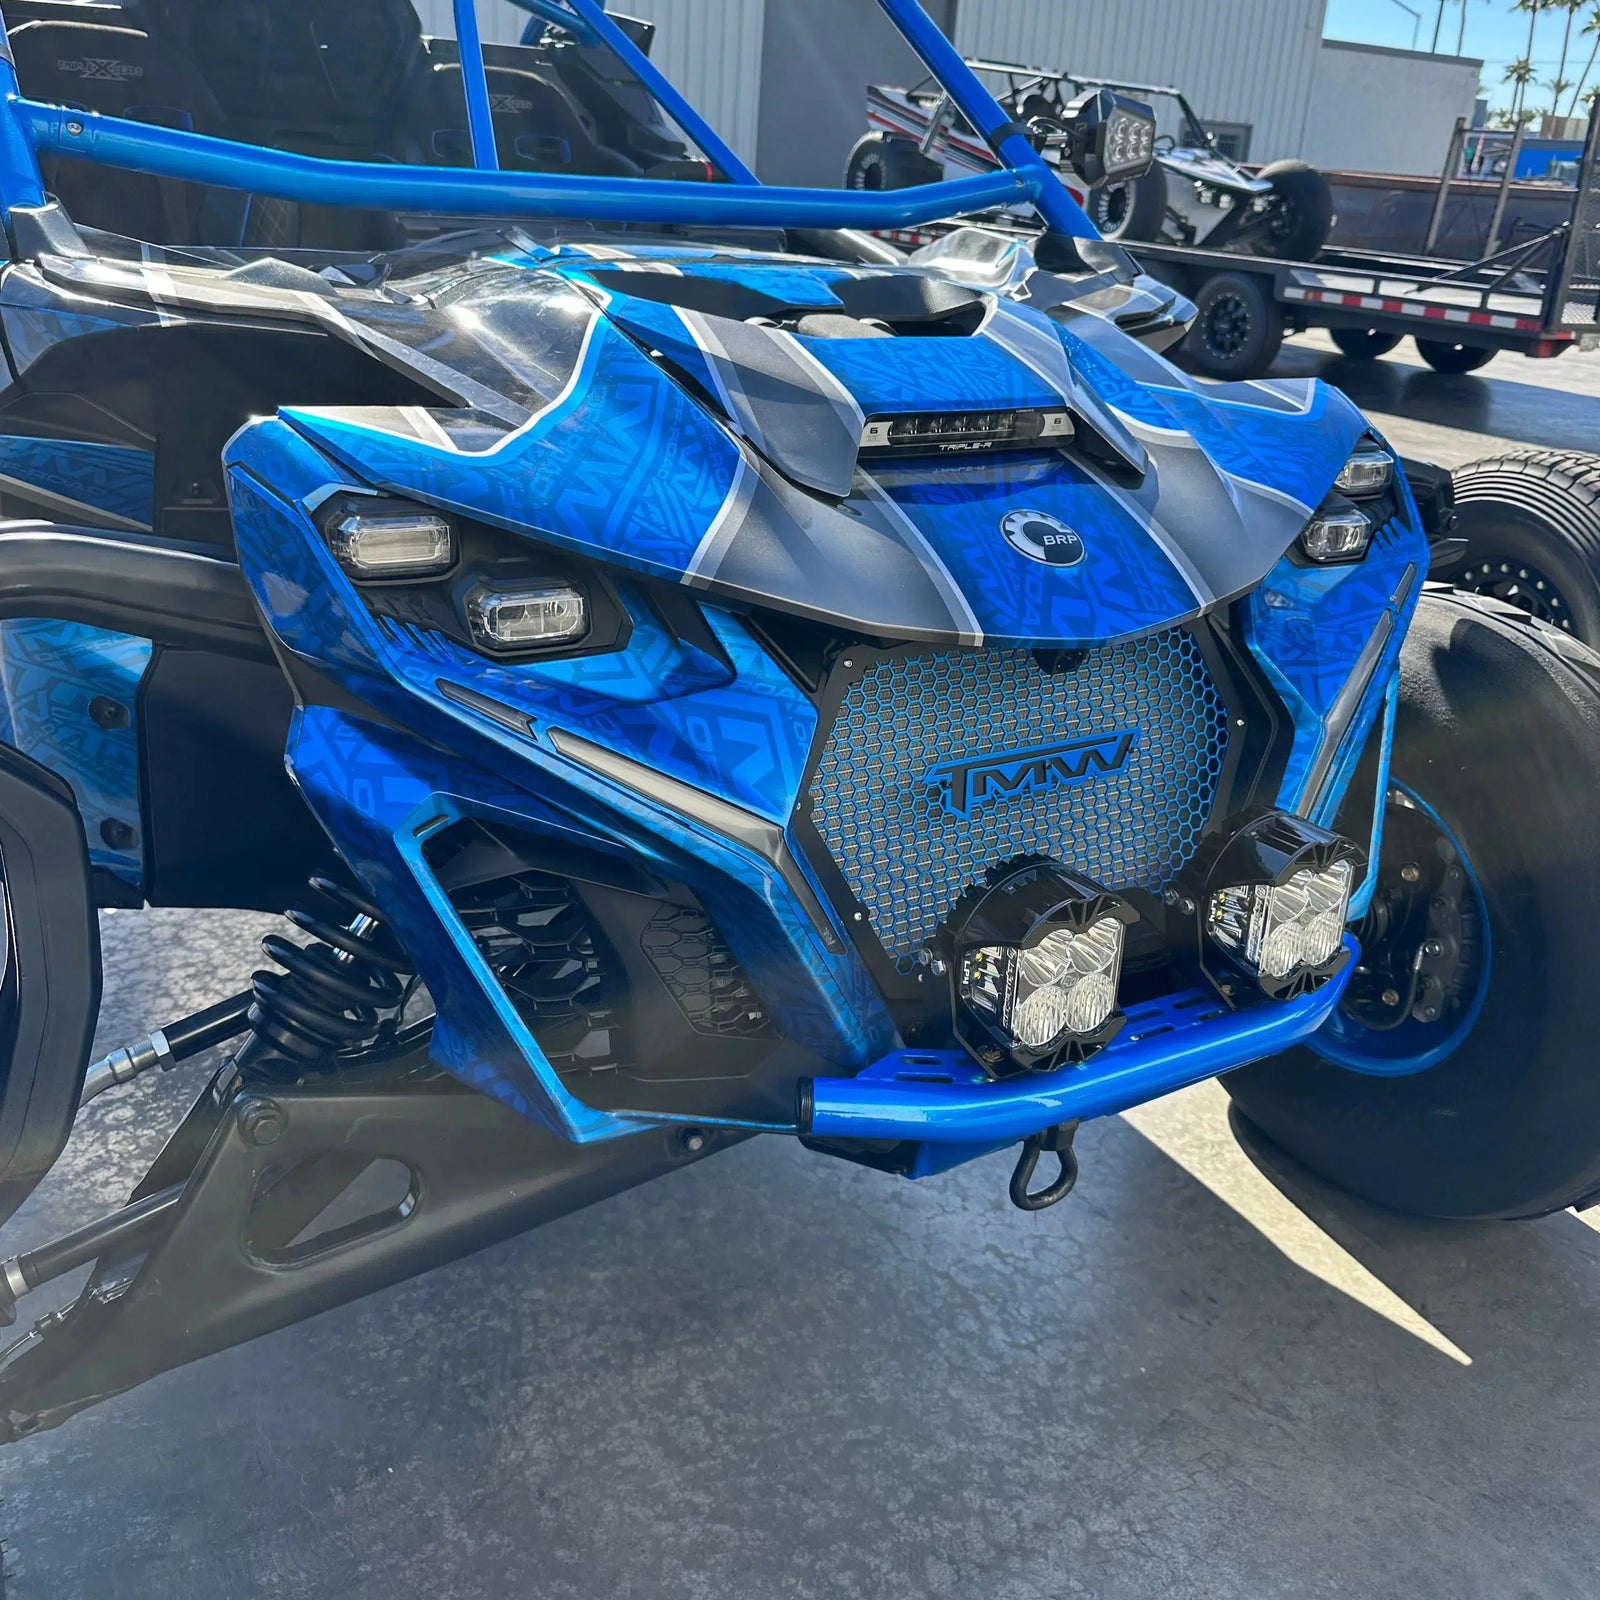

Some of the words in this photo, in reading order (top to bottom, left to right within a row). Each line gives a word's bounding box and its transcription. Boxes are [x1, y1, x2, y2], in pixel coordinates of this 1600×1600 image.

[938, 441, 993, 453] TRIPLE-R
[1043, 534, 1078, 546] BRP
[932, 731, 1137, 815] TMW
[962, 960, 971, 985] LP4
